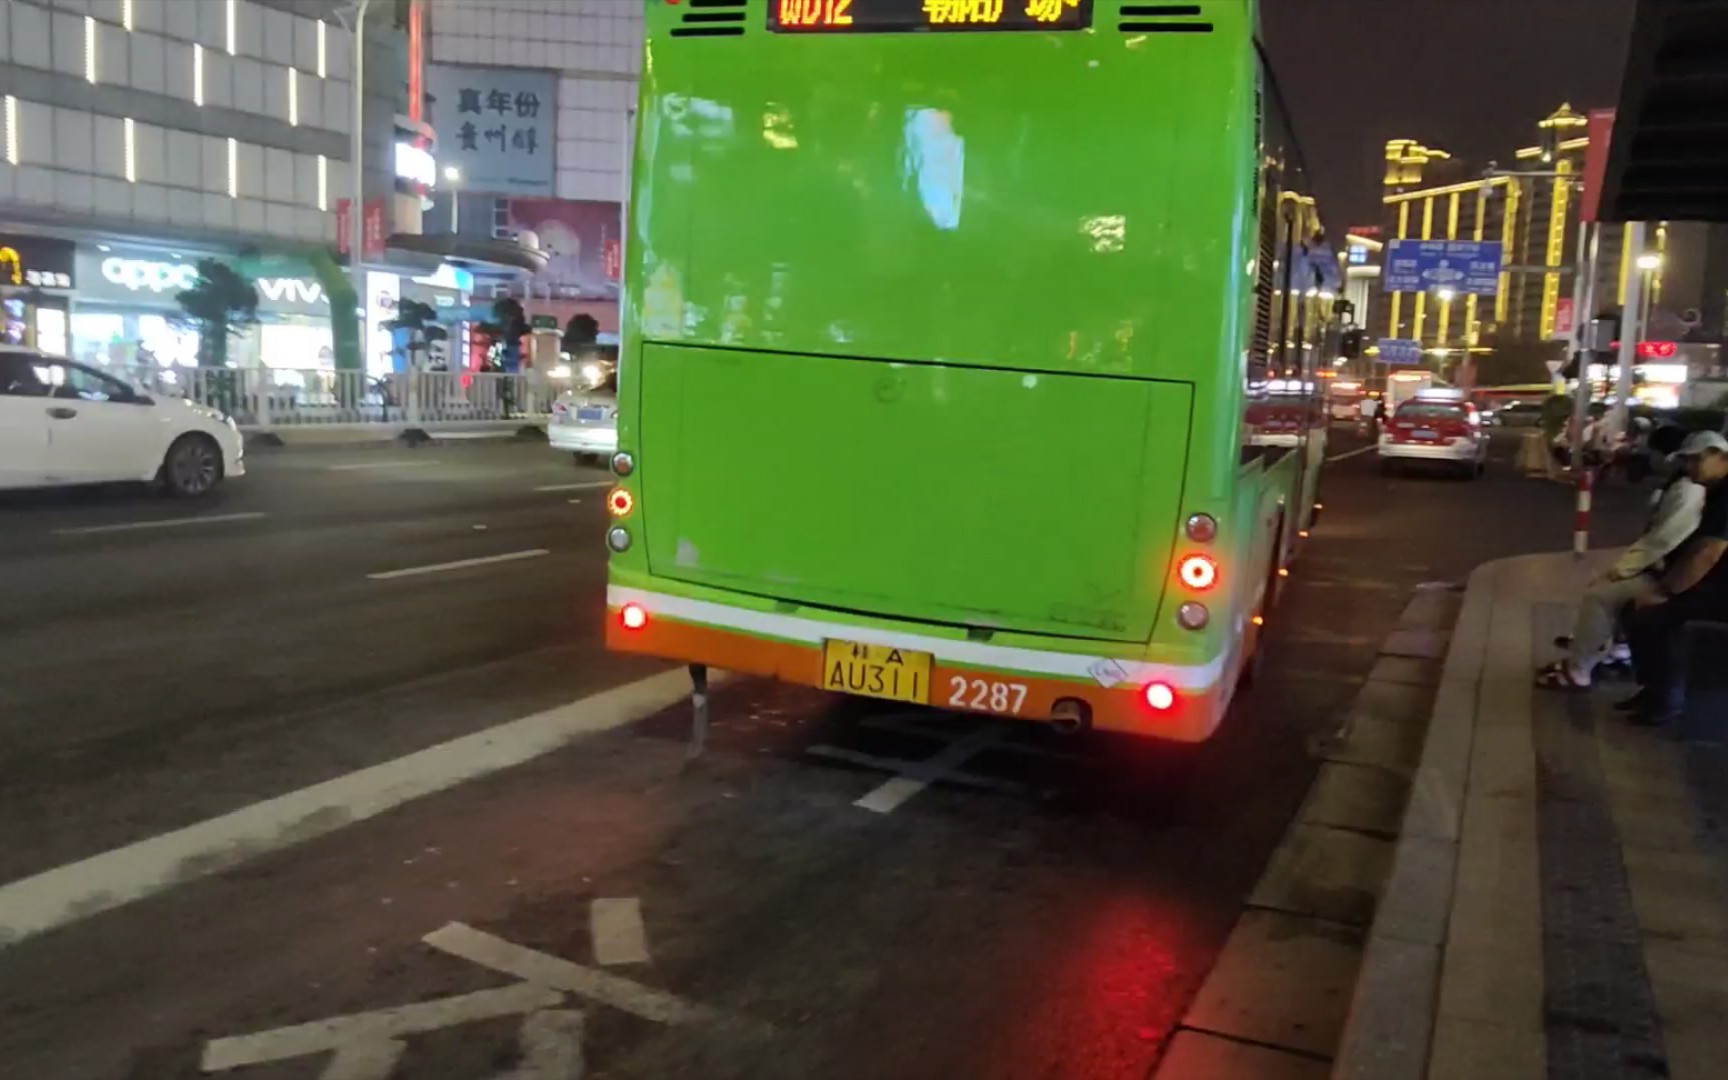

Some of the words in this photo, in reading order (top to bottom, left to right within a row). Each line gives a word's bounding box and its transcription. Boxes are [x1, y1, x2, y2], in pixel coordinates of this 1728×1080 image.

[457, 88, 540, 118] 真年份
[257, 276, 330, 304] viv
[829, 659, 919, 699] AU311
[948, 675, 1028, 714] 2287
